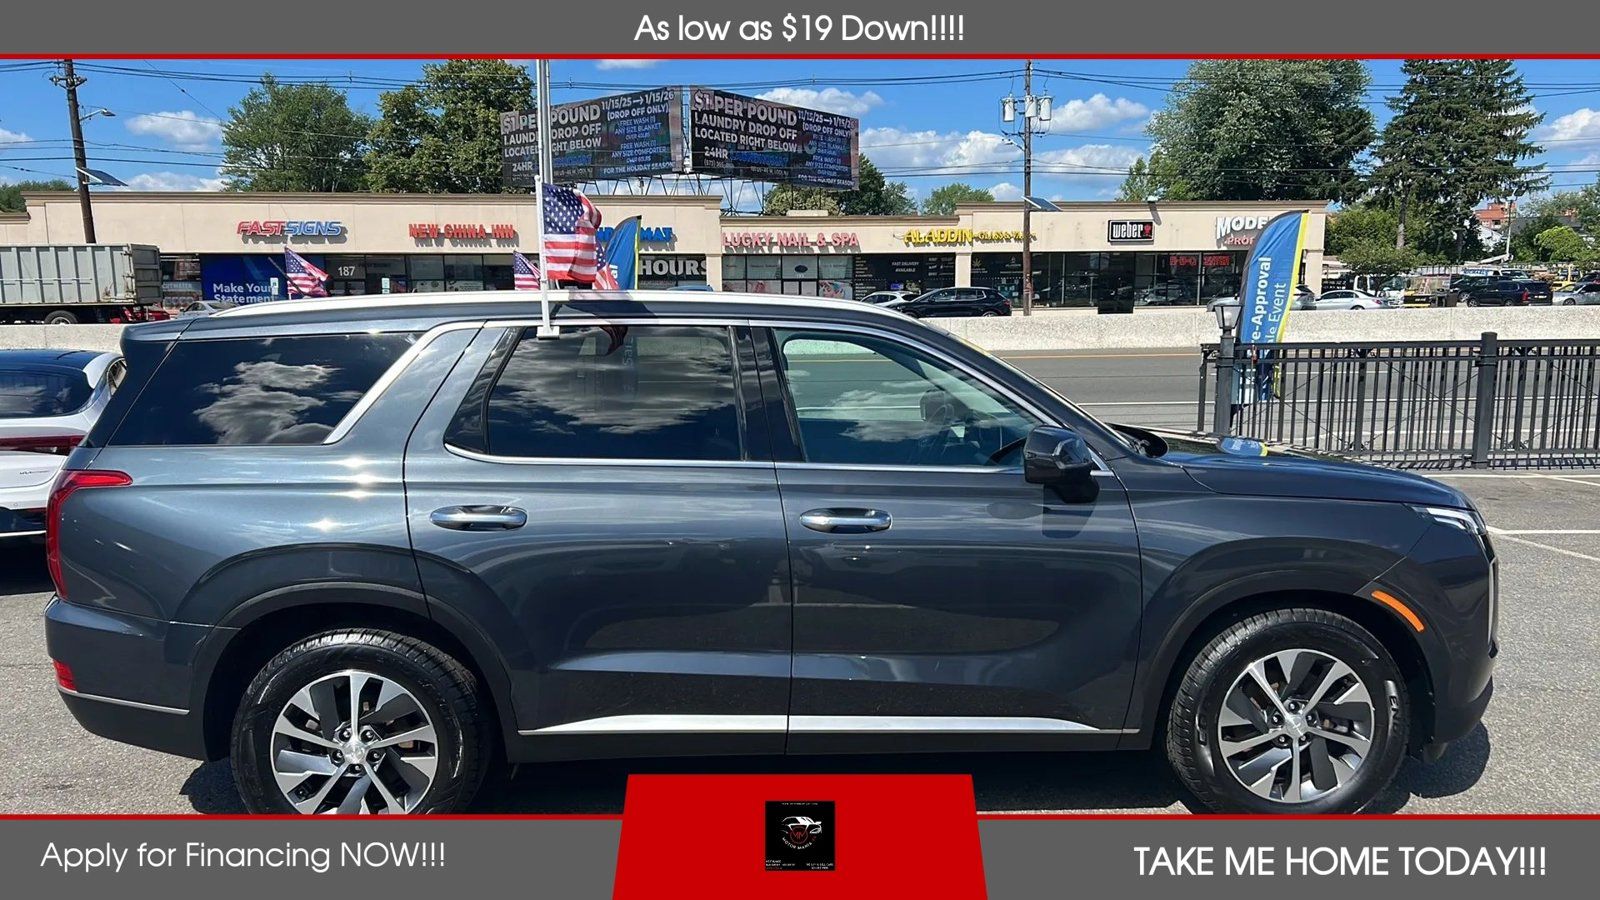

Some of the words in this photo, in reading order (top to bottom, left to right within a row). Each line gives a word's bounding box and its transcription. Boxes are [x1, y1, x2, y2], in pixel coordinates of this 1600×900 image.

[601, 96, 632, 110] 11/15/25
[645, 90, 674, 104] 1/15/26
[520, 114, 538, 130] PE
[550, 104, 601, 126] POUND
[607, 108, 630, 121] (DROP
[631, 107, 646, 117] OFF
[647, 103, 669, 114] ONLY)
[714, 95, 743, 117] PER
[747, 102, 797, 126] POUND
[797, 110, 824, 123] 11/15/25
[694, 112, 746, 132] LAUNDRY
[748, 121, 777, 137] DROP
[779, 128, 798, 140] OFF
[822, 126, 834, 135] OFF
[504, 131, 540, 146] LAUND
[551, 126, 579, 140] DROP
[581, 123, 602, 136] OFF
[694, 127, 738, 143] LOCATED
[739, 135, 765, 148] RIGHT
[767, 140, 797, 153] BELOW
[569, 137, 602, 149] BELOW
[704, 146, 729, 159] 24HR
[512, 161, 534, 172] 24HR
[236, 220, 342, 236] FASTSIGNS
[408, 223, 440, 238] NEW
[443, 223, 486, 239] CHINA
[491, 224, 514, 239] INN
[903, 228, 973, 244] ALADDIN
[1112, 221, 1144, 238] weber
[1216, 216, 1270, 240] MODE
[722, 232, 772, 247] LUCKY
[776, 232, 811, 247] NAIL
[816, 232, 827, 247] &
[830, 232, 859, 247] SPA
[1226, 236, 1255, 245] PRO
[337, 265, 356, 276] 187
[213, 282, 244, 293] Make
[245, 283, 274, 293] Your
[1251, 257, 1273, 344] e-Approval
[1268, 283, 1287, 321] Event
